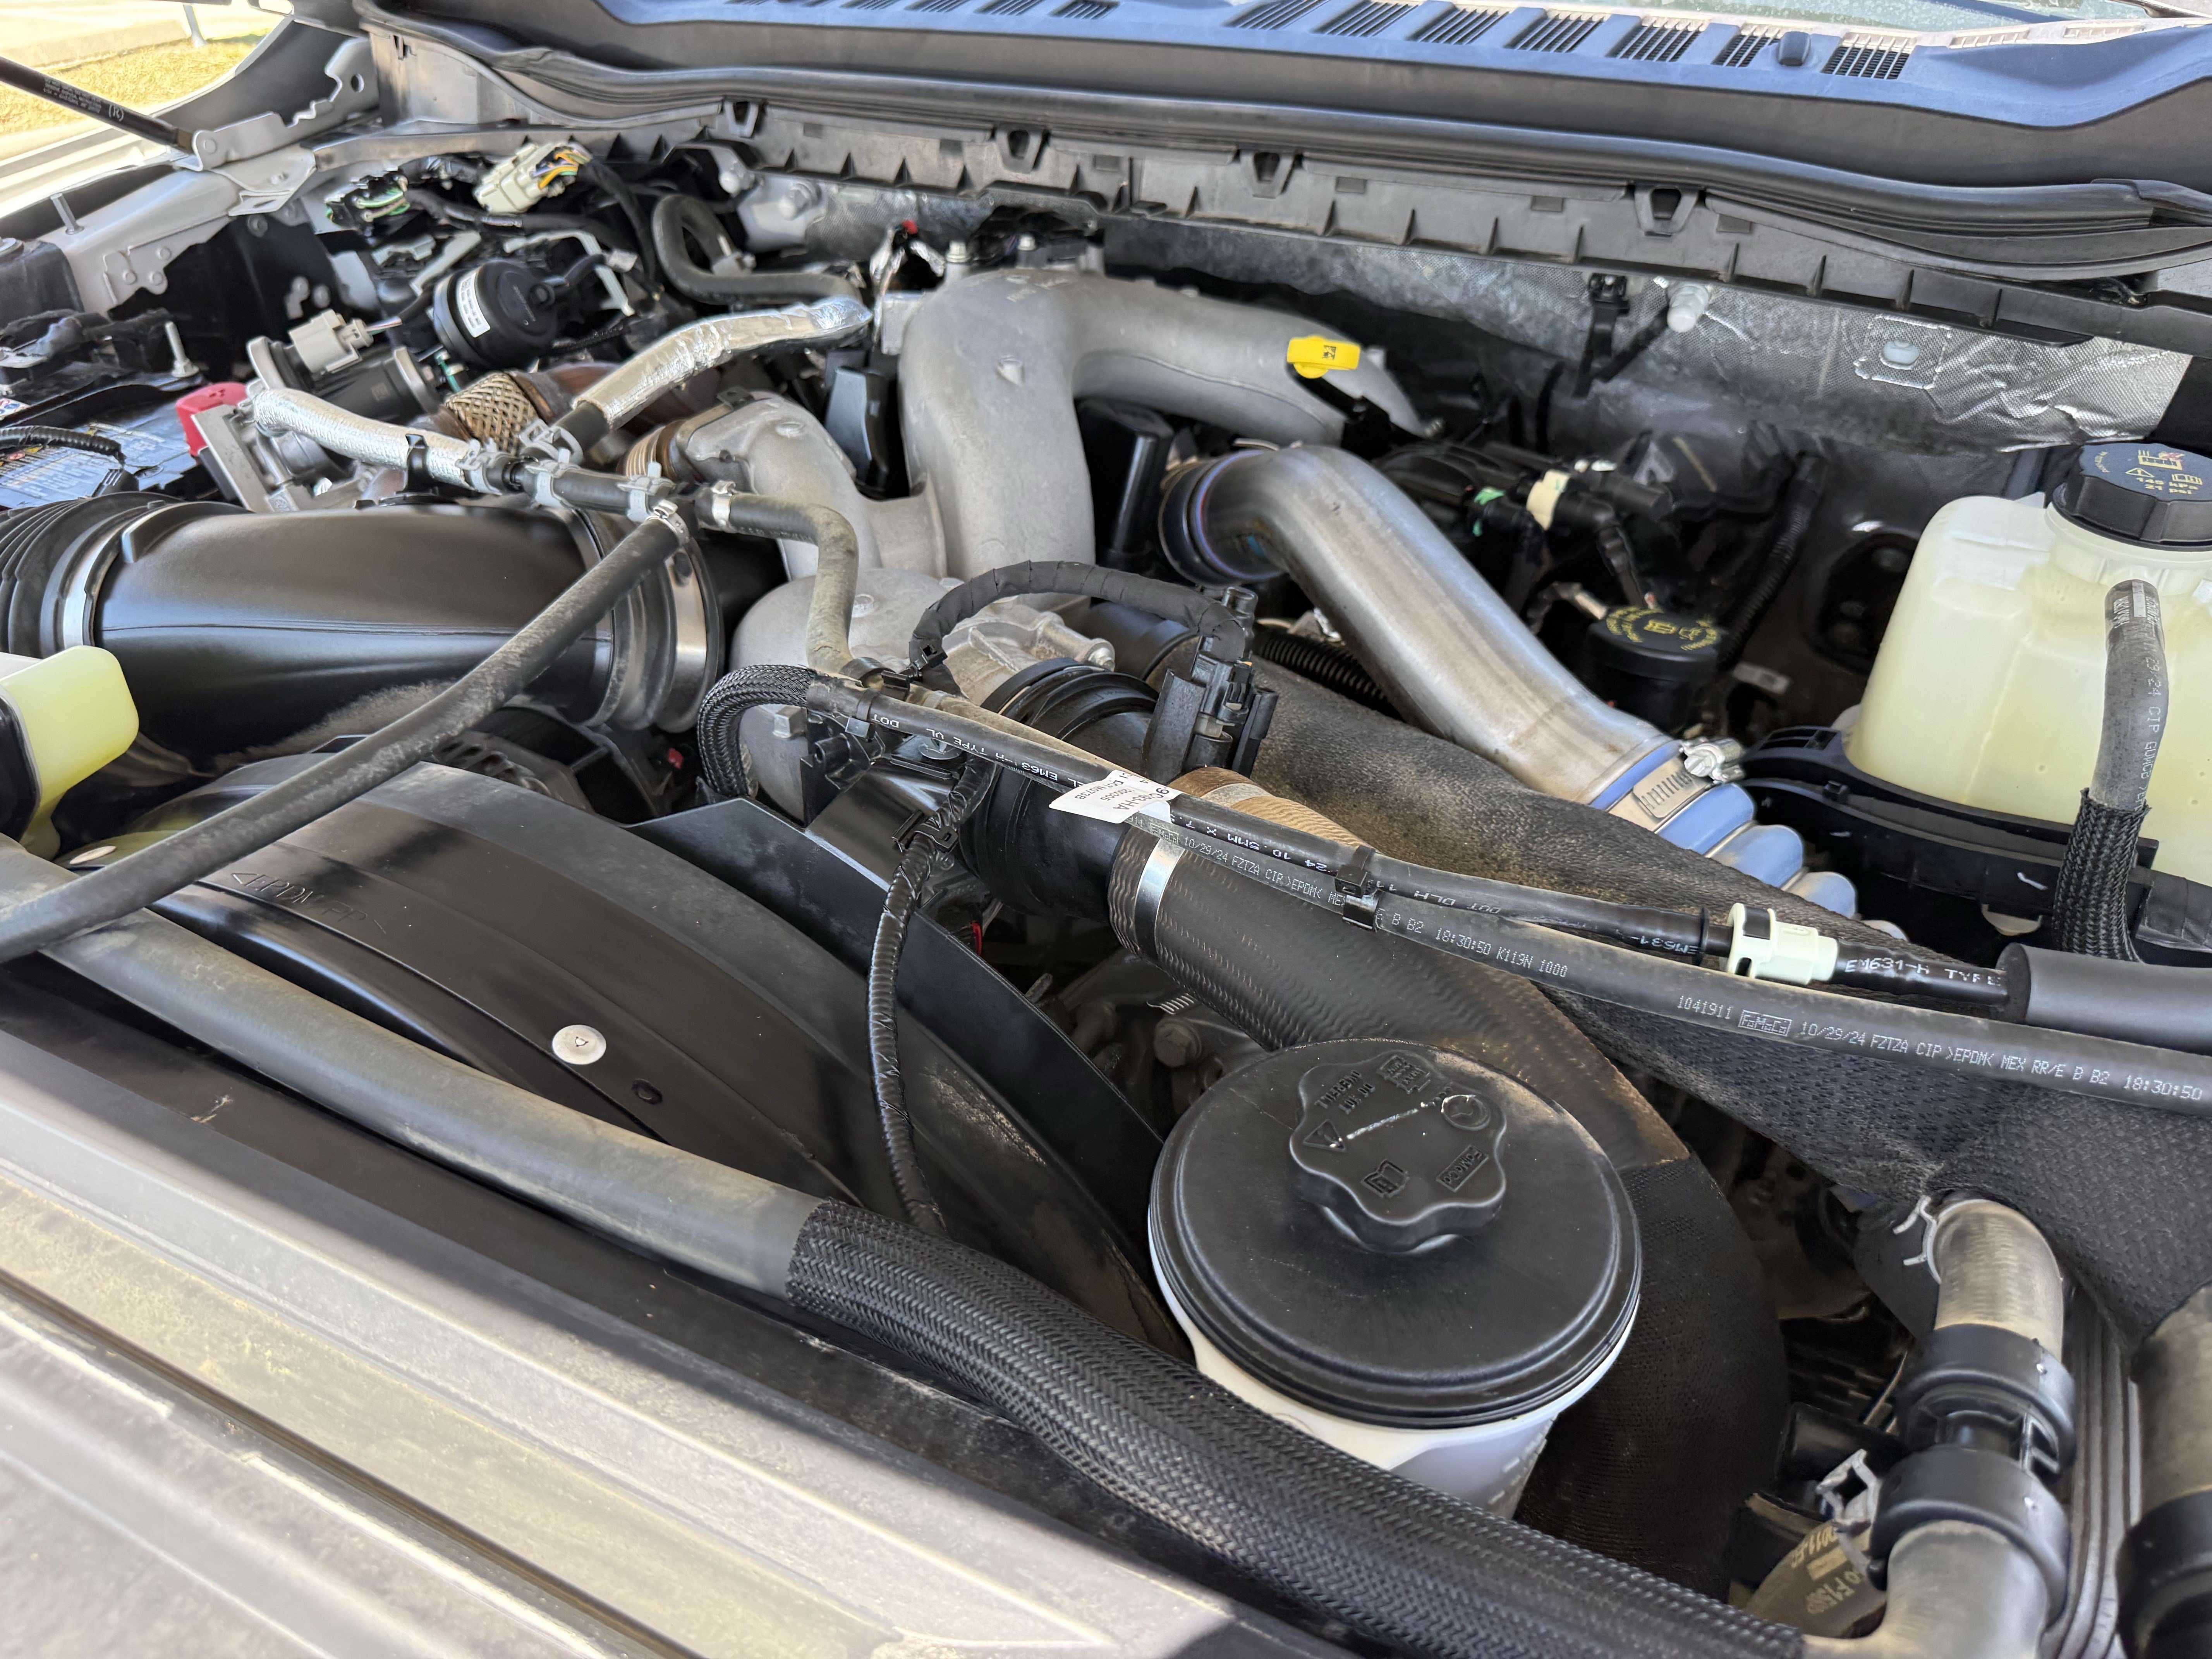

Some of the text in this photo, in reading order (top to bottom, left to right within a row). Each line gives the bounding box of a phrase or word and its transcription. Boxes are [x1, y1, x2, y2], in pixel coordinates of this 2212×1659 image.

[869, 714, 900, 728] DOT
[953, 737, 988, 756] TYPE
[995, 752, 1058, 781] EM63-H
[1185, 836, 1228, 862] 10/29/24
[1265, 869, 1283, 884] CIP
[1435, 928, 1492, 955] 18:30:50
[1538, 959, 1568, 977] 1000
[1677, 995, 1733, 1020] 1041911
[1800, 1021, 1865, 1046] 10/29/24
[1916, 1042, 1942, 1058] CIP
[2000, 1055, 2026, 1072] MEX
[2031, 1060, 2066, 1078] RR/E
[2072, 1066, 2084, 1080] B
[2089, 1069, 2110, 1085] B2
[2123, 1075, 2203, 1100] 18:30:50
